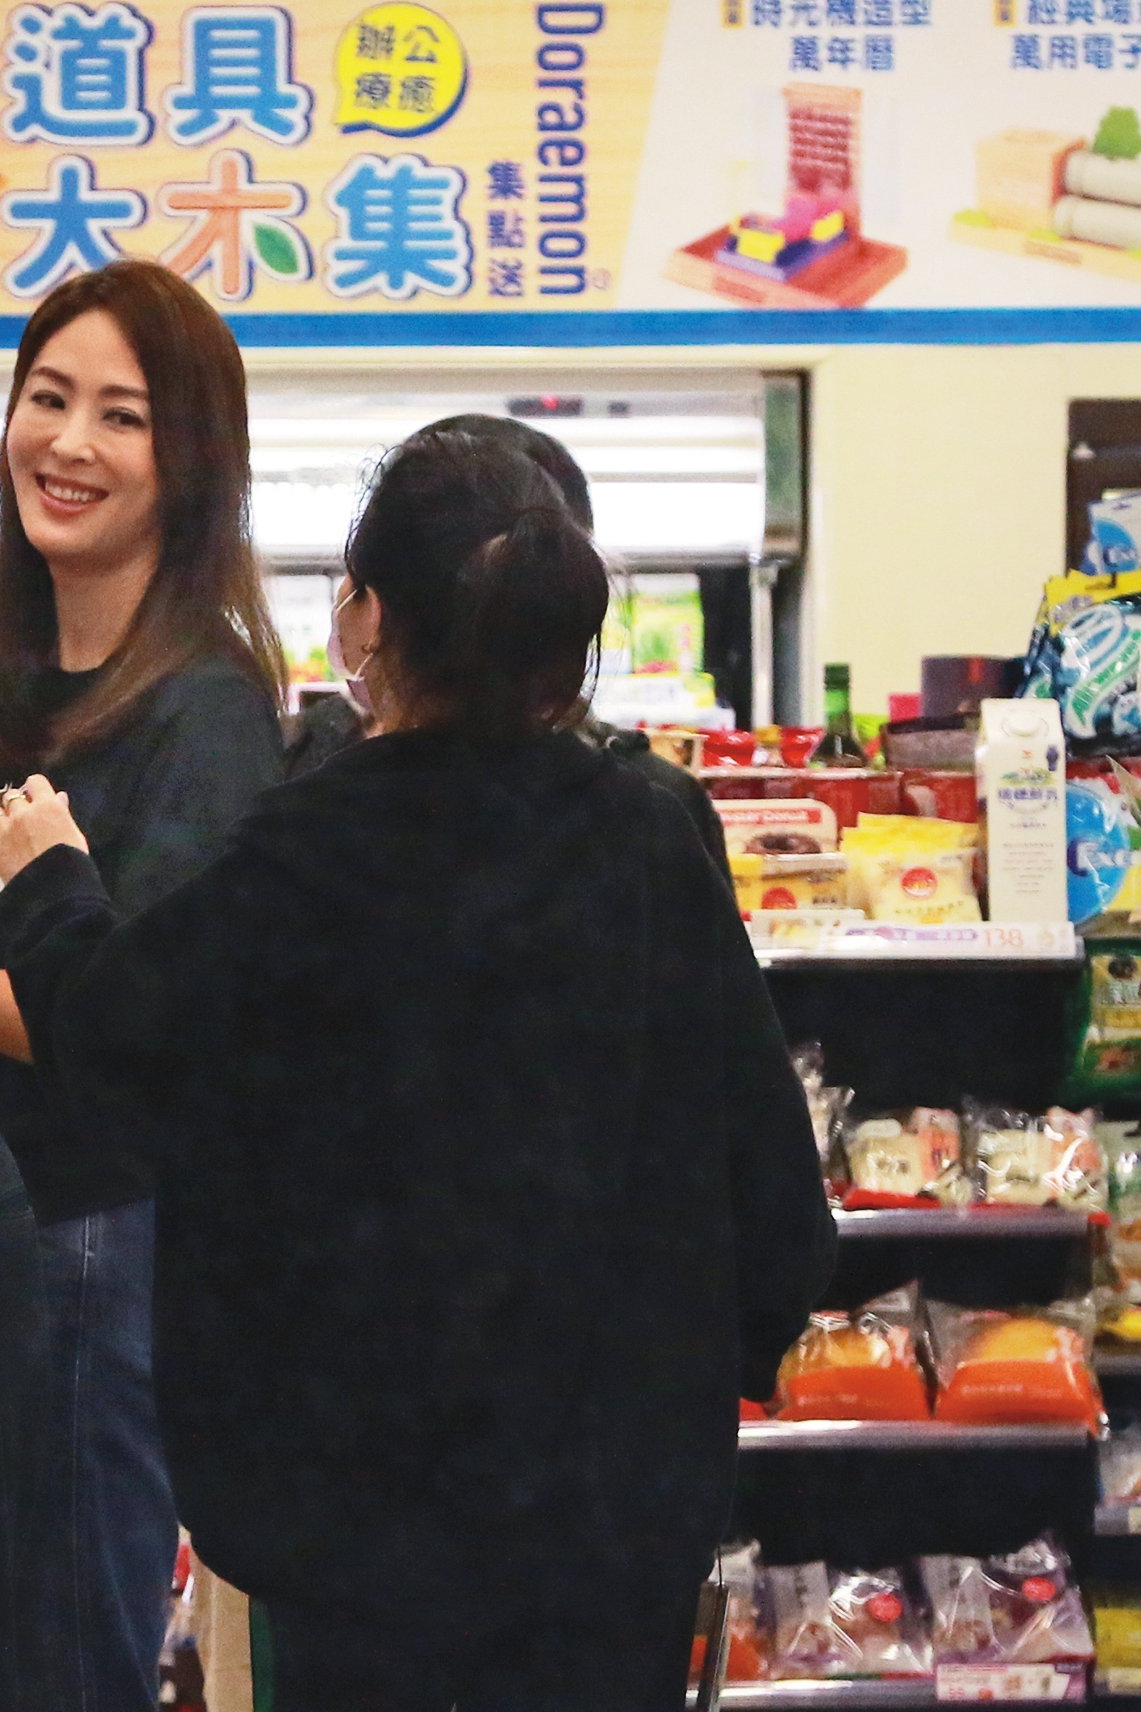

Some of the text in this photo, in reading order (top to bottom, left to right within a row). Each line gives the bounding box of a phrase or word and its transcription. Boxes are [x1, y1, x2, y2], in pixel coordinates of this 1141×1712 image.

[4, 5, 311, 146] 道具
[536, 3, 605, 295] Doraemon
[2, 150, 472, 299] 大木集
